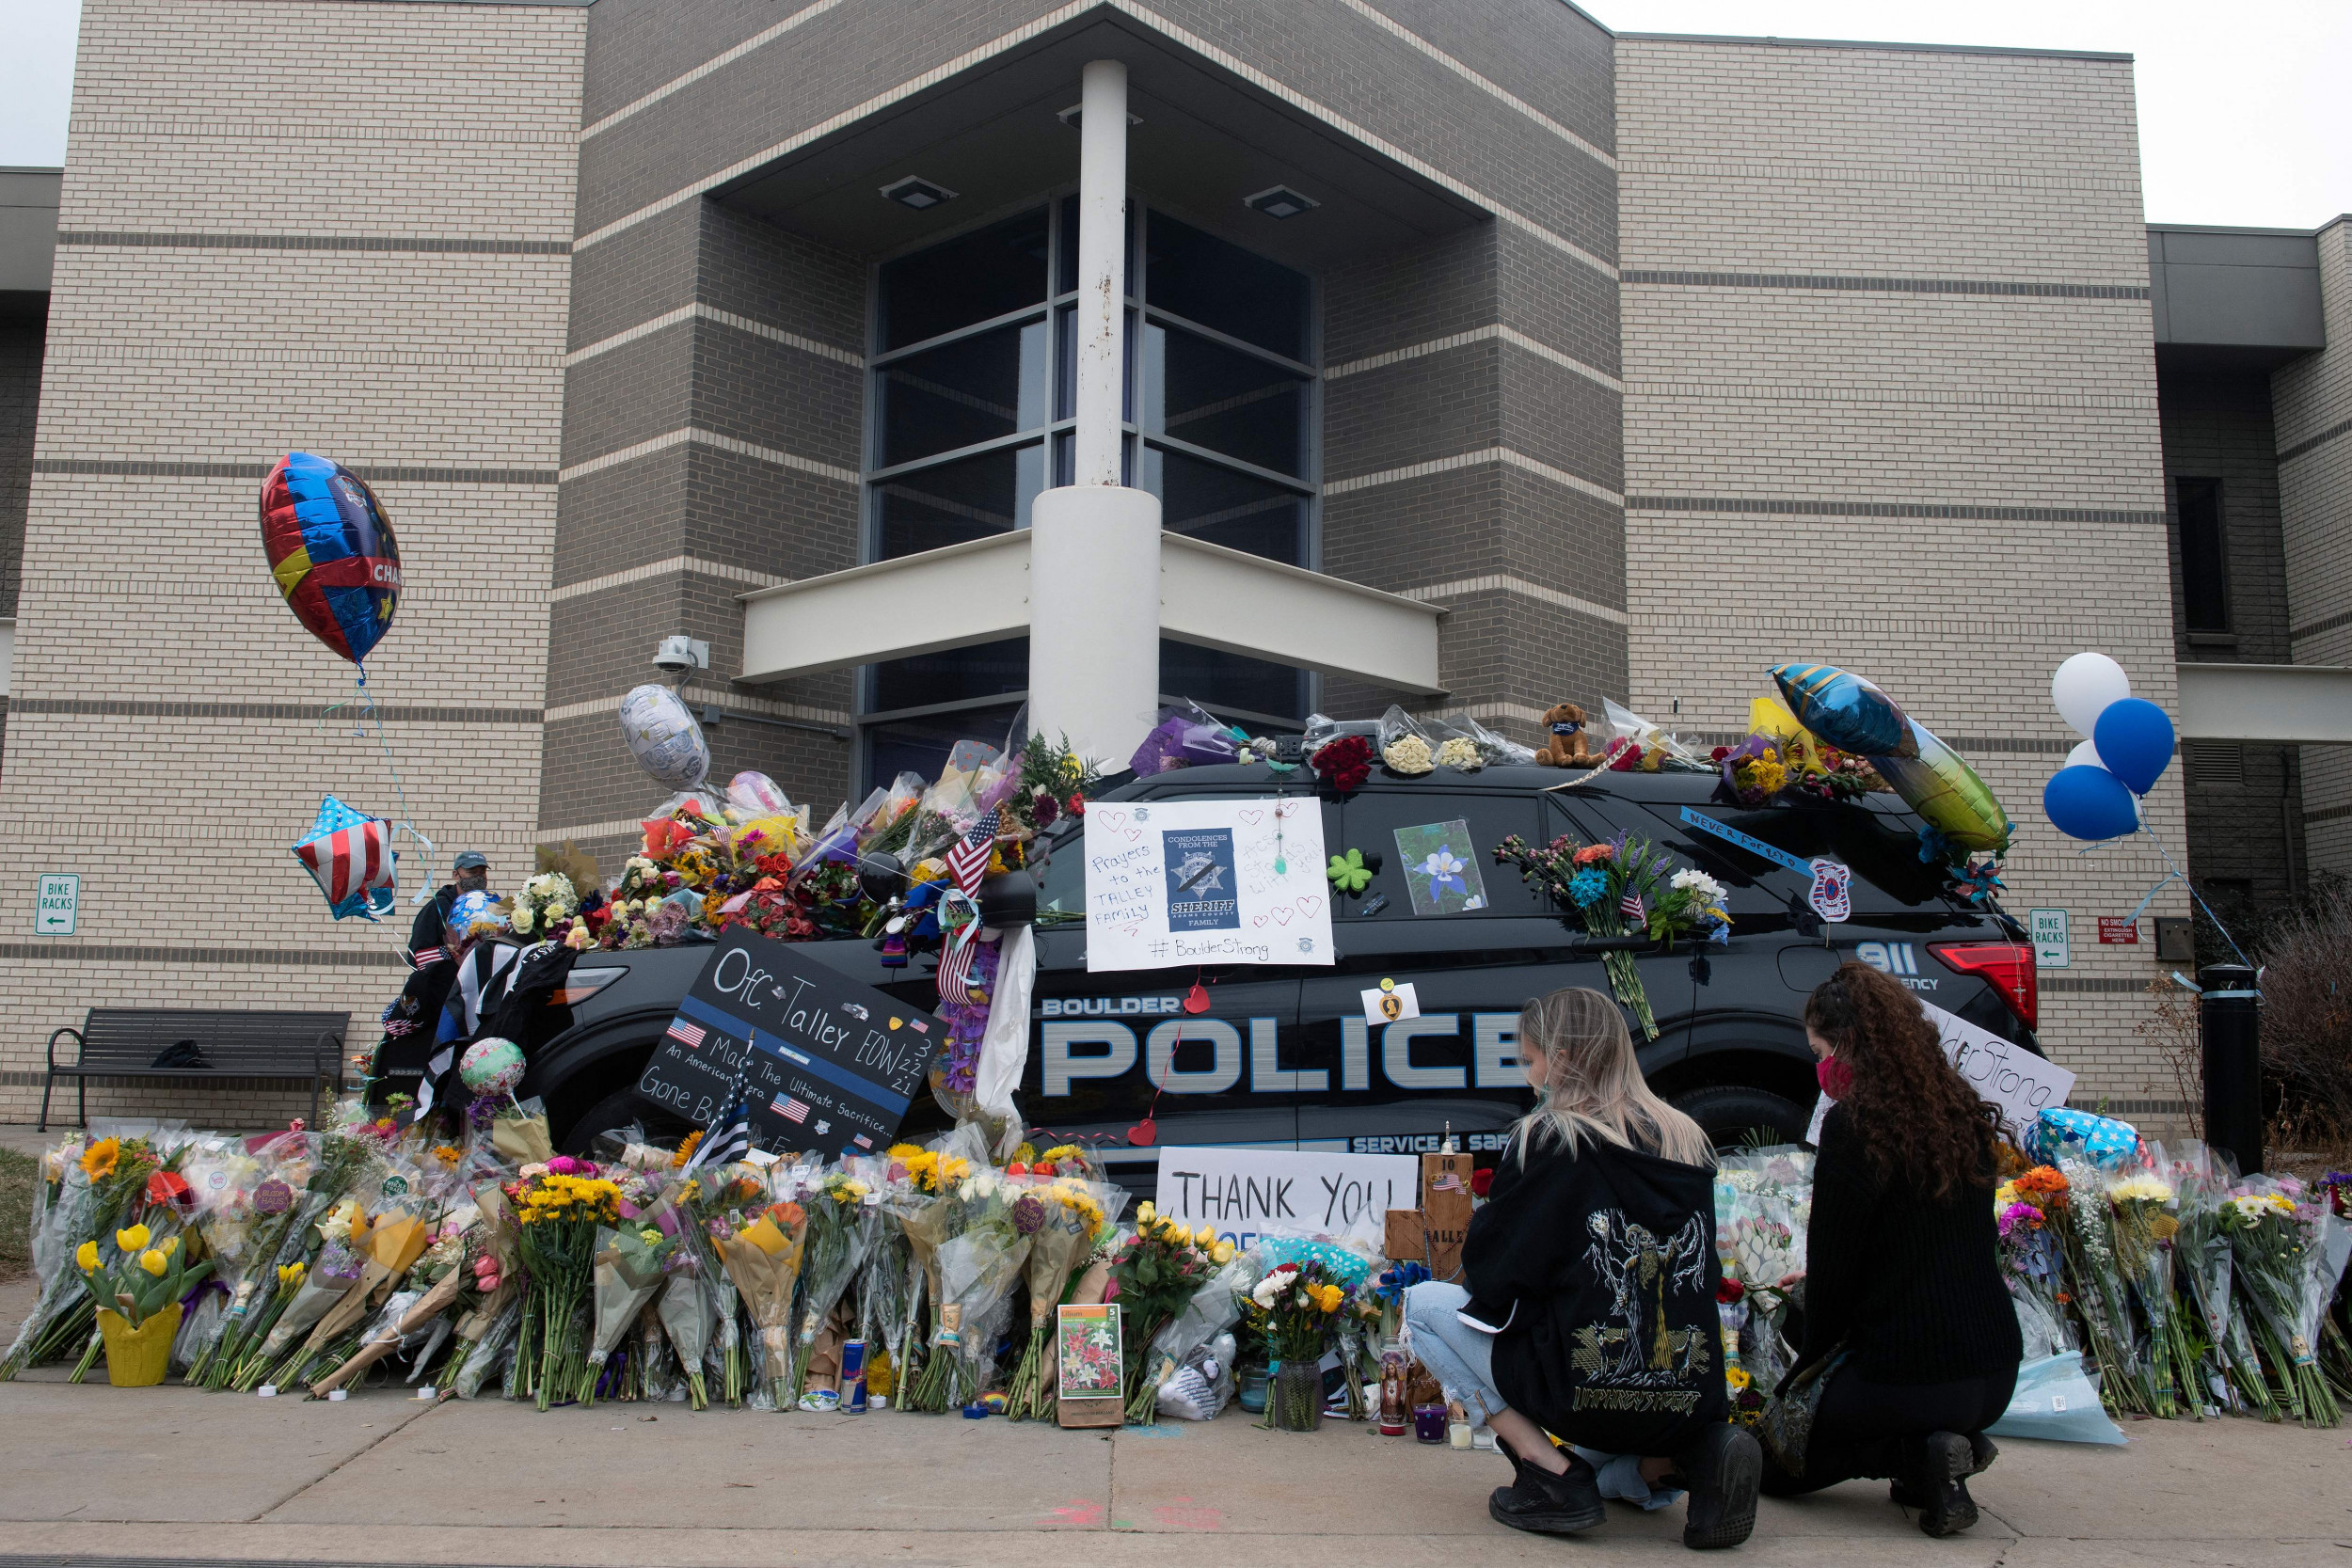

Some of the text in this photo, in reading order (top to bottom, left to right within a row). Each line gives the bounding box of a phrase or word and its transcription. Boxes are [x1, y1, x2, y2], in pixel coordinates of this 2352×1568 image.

[1168, 834, 1228, 844] CONDOLENCES
[1092, 846, 1151, 874] Prayers
[1109, 865, 1161, 886] to the
[48, 883, 70, 895] BIKE
[1093, 885, 1152, 907] TALLEY
[42, 898, 72, 910] RACKS
[1171, 899, 1234, 913] SHERIFF
[2039, 917, 2058, 929] BIKE
[2035, 932, 2064, 943] RACKS
[1856, 942, 1918, 974] 911
[1041, 997, 1180, 1015] BOULDER
[666, 1044, 681, 1059] An
[855, 1029, 906, 1076] EOW
[1041, 1012, 1532, 1097] POLICE
[640, 1066, 691, 1109] Gone
[760, 1061, 781, 1085] The
[789, 1077, 833, 1108] Ultimate
[1353, 1134, 1439, 1153] SERVICE
[1441, 1158, 1455, 1171] 10
[387, 1180, 406, 1189] WHOLE
[1172, 1171, 1392, 1227] THANK YOU
[1017, 1212, 1035, 1227] HAUS
[1020, 1204, 1039, 1220] BLOOM
